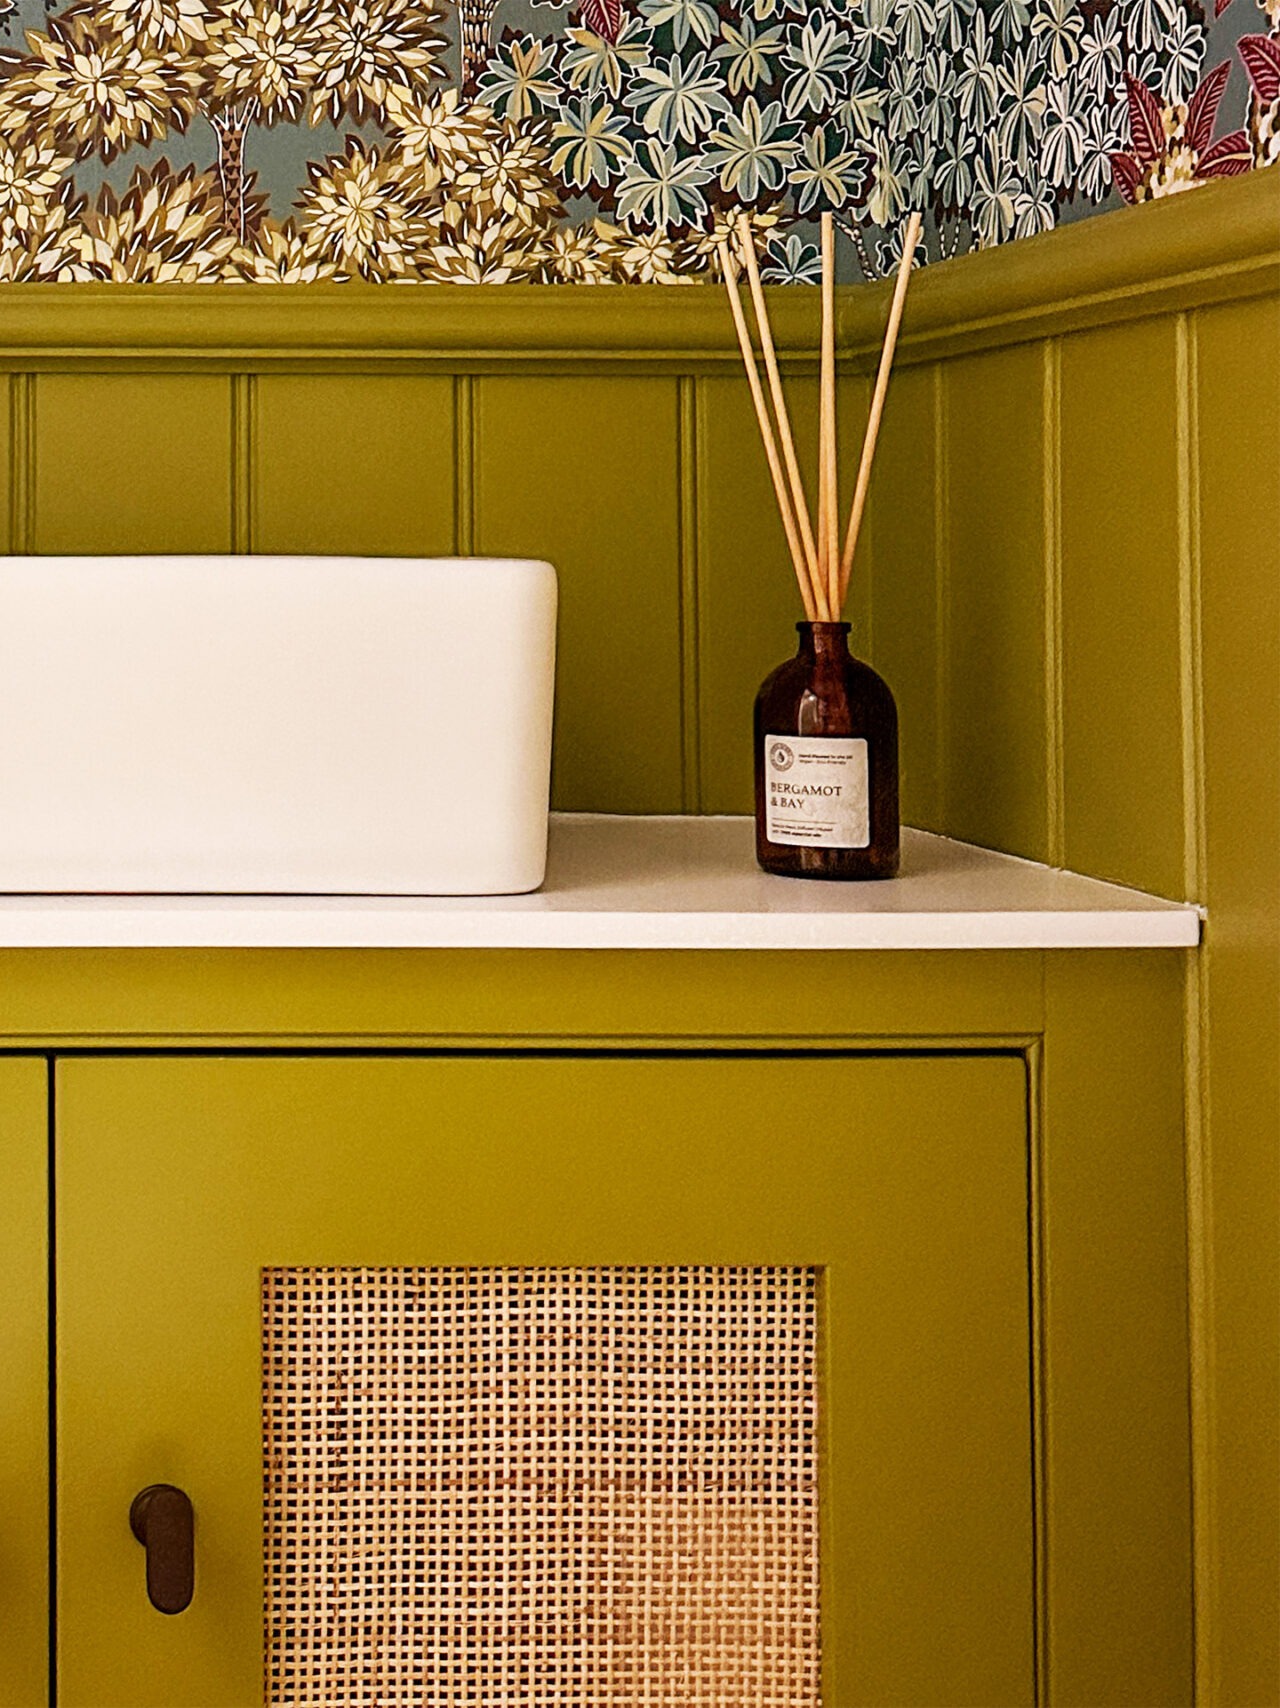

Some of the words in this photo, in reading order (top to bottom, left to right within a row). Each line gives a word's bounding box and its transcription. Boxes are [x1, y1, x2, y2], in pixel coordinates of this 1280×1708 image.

[770, 782, 842, 796] BERGAMOT
[770, 797, 778, 806] &
[780, 797, 805, 808] BAY
